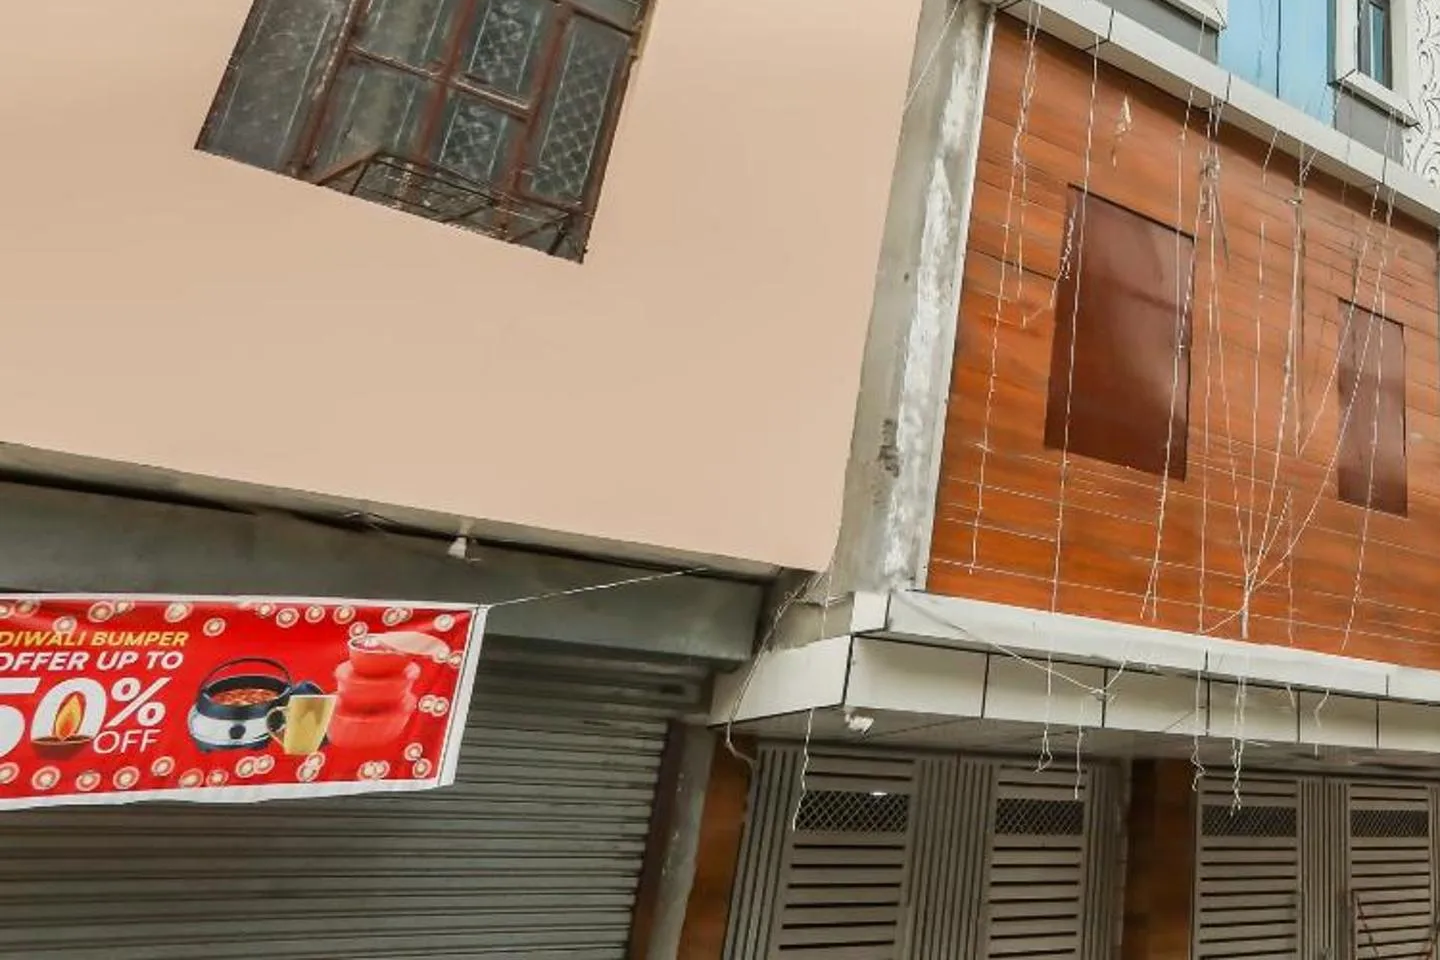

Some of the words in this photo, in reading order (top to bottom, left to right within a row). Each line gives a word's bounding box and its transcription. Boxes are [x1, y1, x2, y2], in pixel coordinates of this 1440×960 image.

[0, 630, 86, 647] DIWALI
[91, 631, 189, 647] BUMPER
[96, 651, 139, 671] UP
[147, 651, 184, 670] TO
[93, 728, 162, 754] OFF
